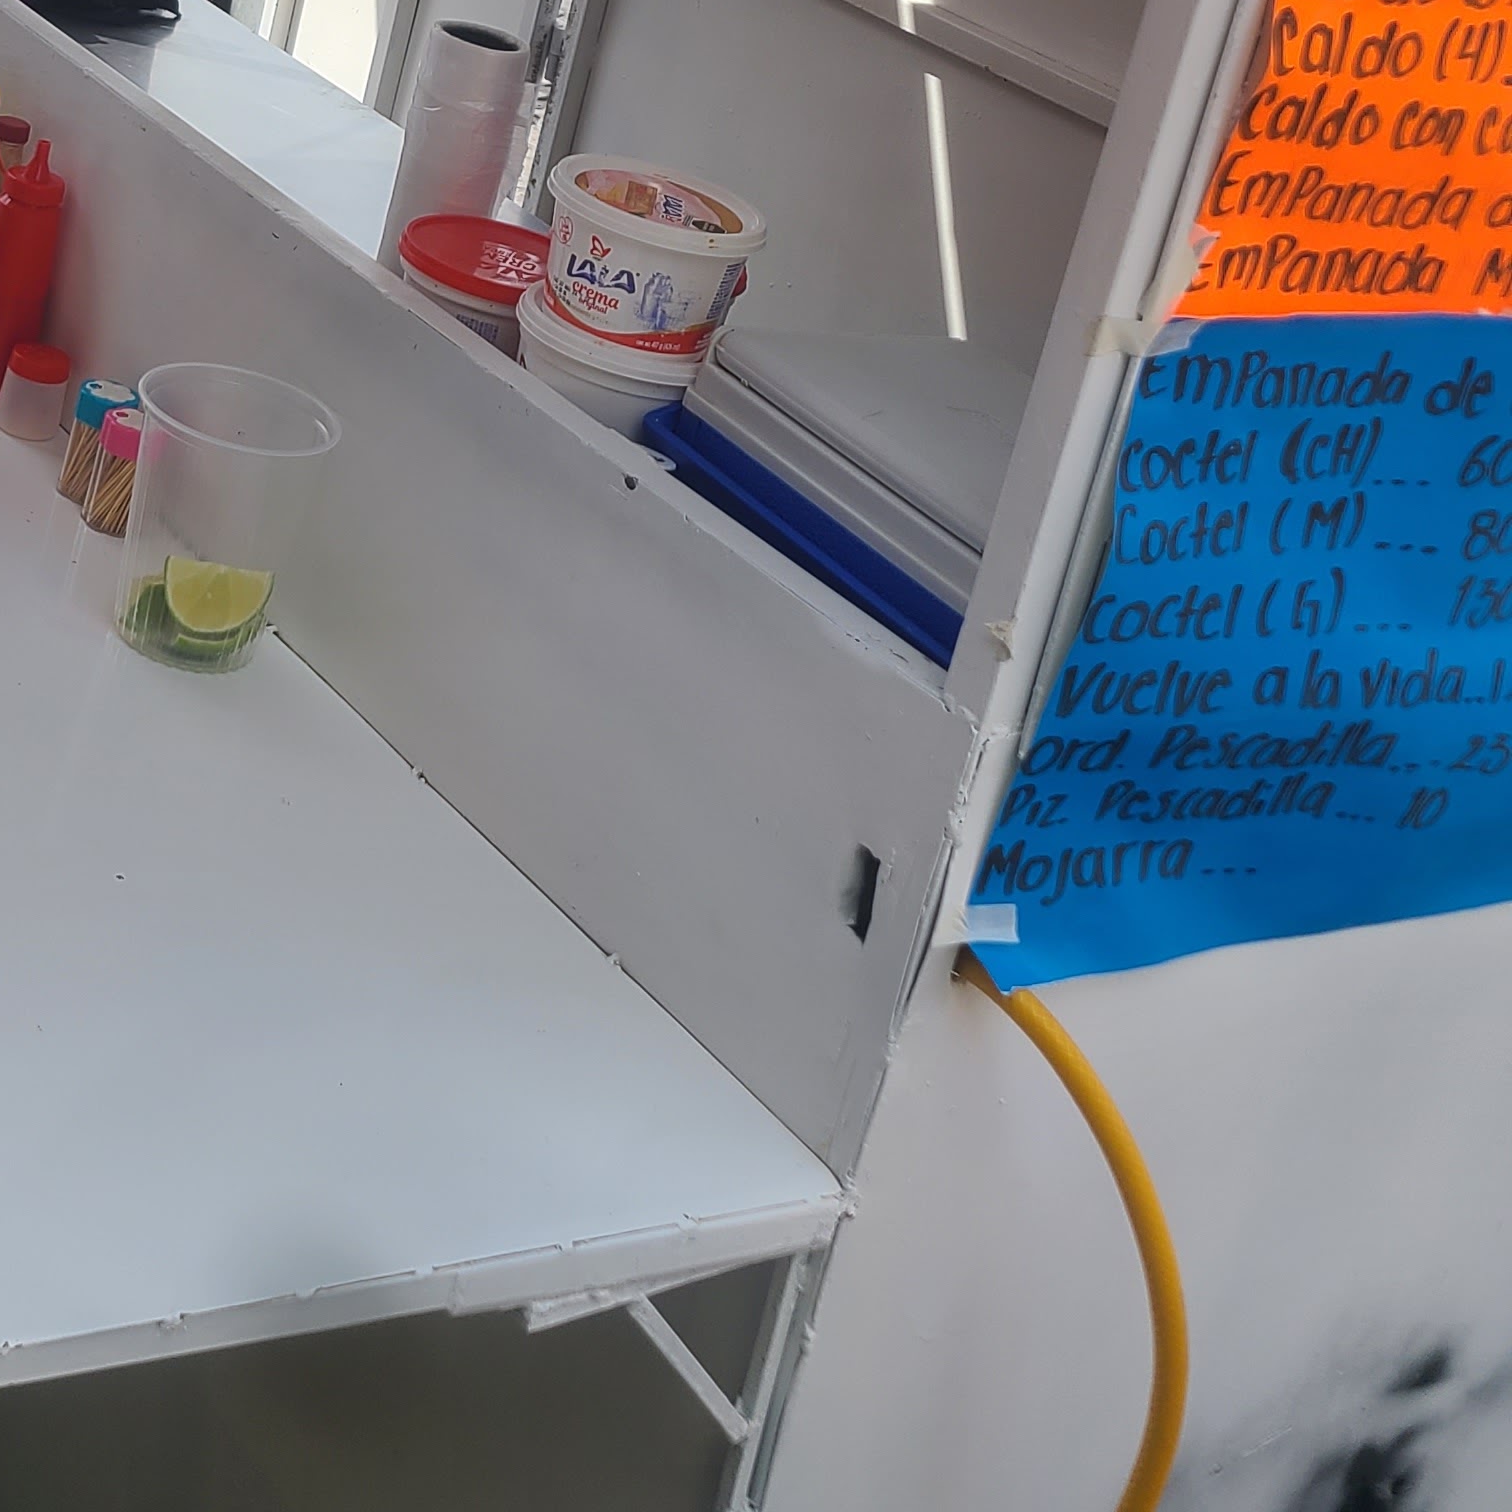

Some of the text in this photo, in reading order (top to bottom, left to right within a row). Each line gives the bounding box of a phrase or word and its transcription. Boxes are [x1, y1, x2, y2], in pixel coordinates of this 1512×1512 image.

[1271, 5, 1425, 80] Caldo
[1238, 81, 1381, 151] Caldo
[1390, 99, 1468, 157] con
[571, 280, 621, 311] crema
[1422, 355, 1496, 419] de
[1251, 664, 1290, 707] a
[1299, 647, 1343, 711] la
[1394, 786, 1451, 831] 10
